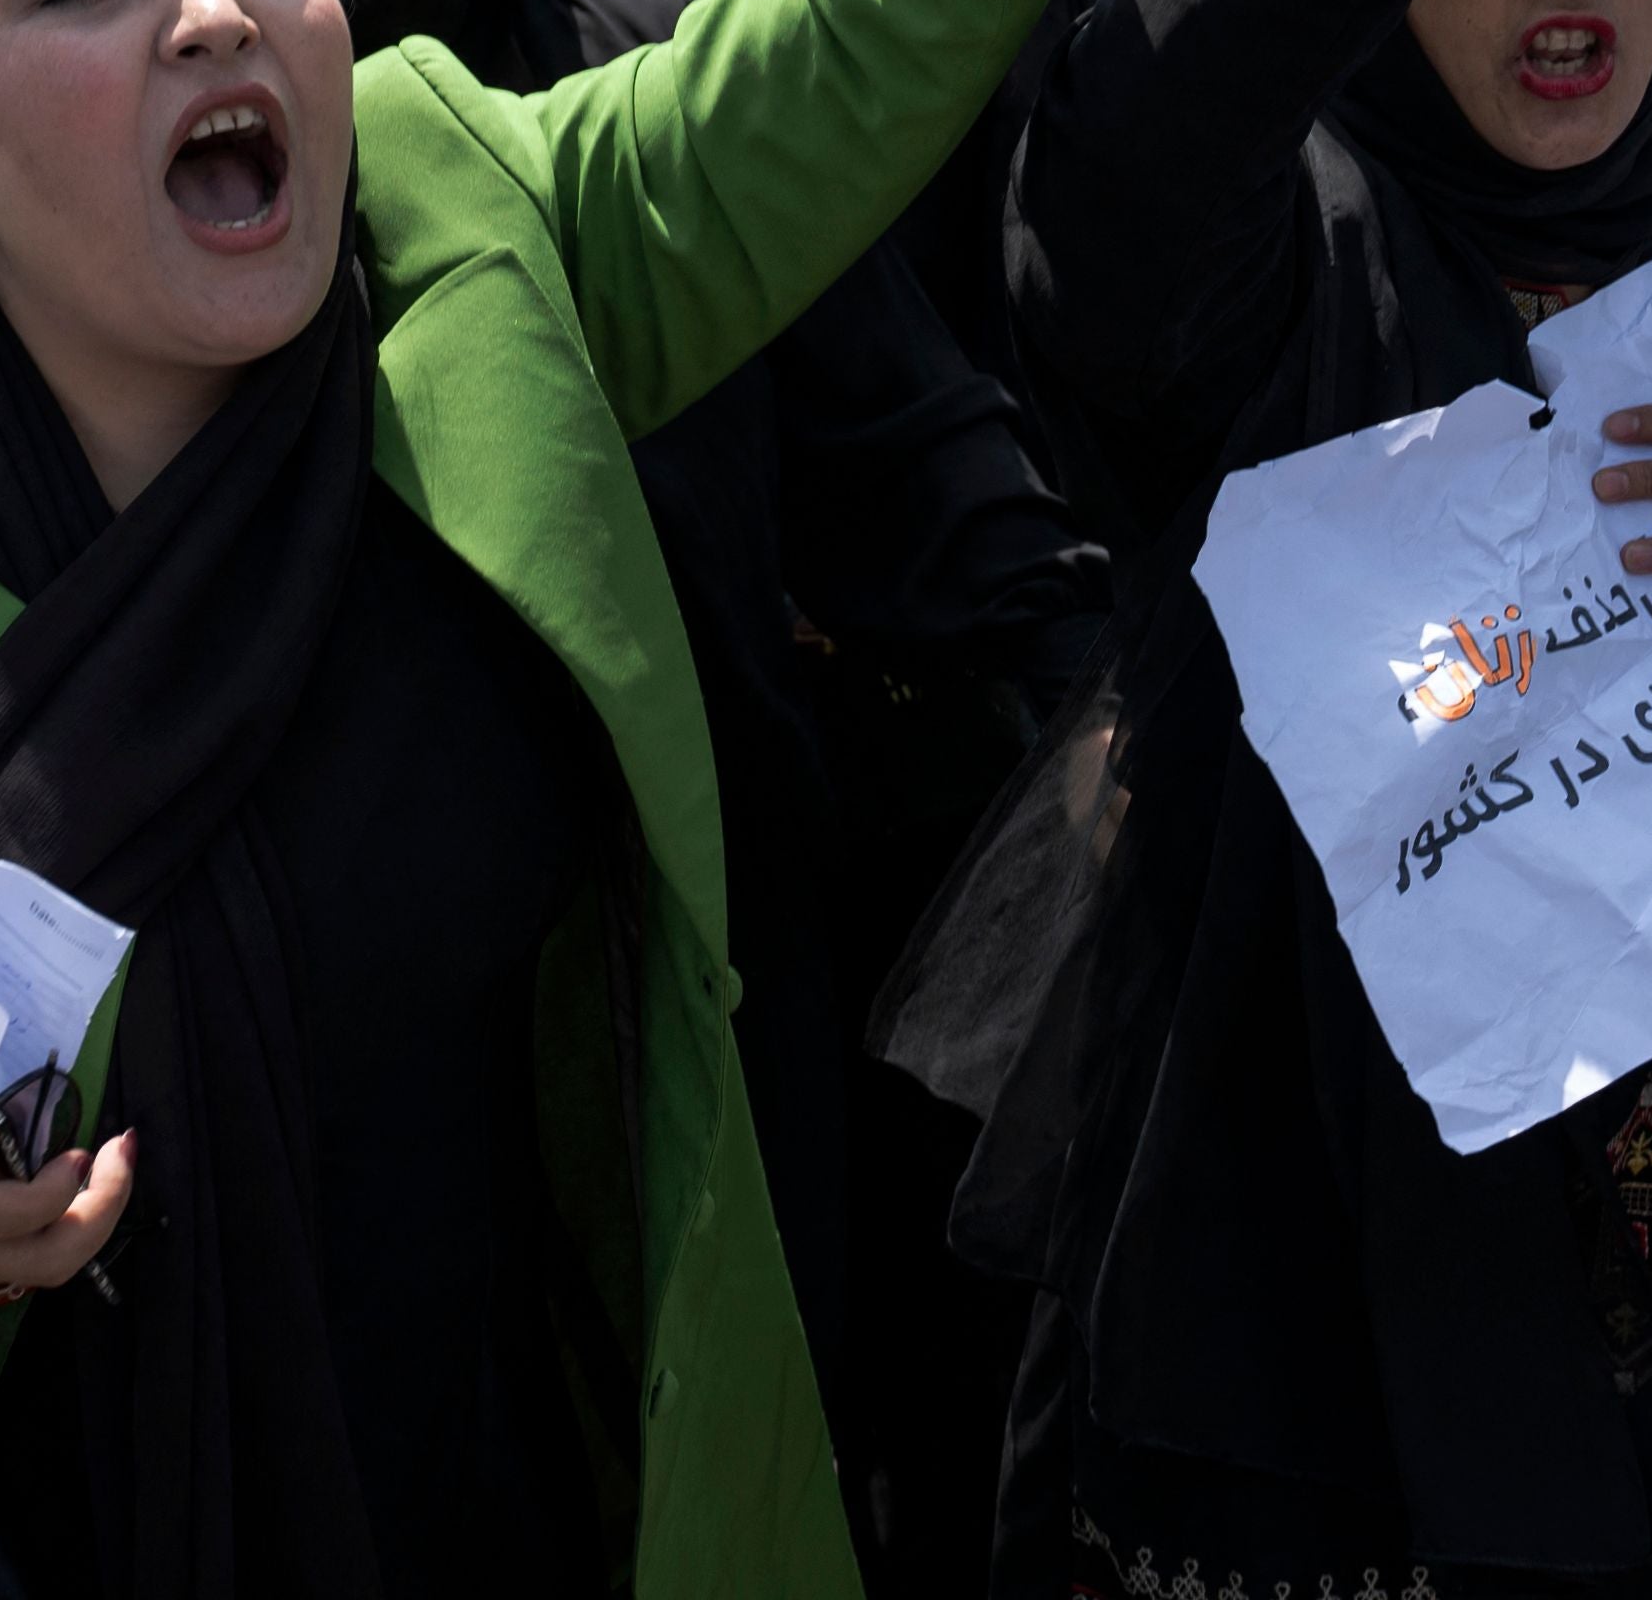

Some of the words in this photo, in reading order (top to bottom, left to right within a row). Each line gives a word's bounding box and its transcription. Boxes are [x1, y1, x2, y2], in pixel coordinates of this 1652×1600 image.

[1544, 575, 1640, 654] حذف
[1547, 738, 1611, 810] در
[1394, 752, 1537, 894] کشور
